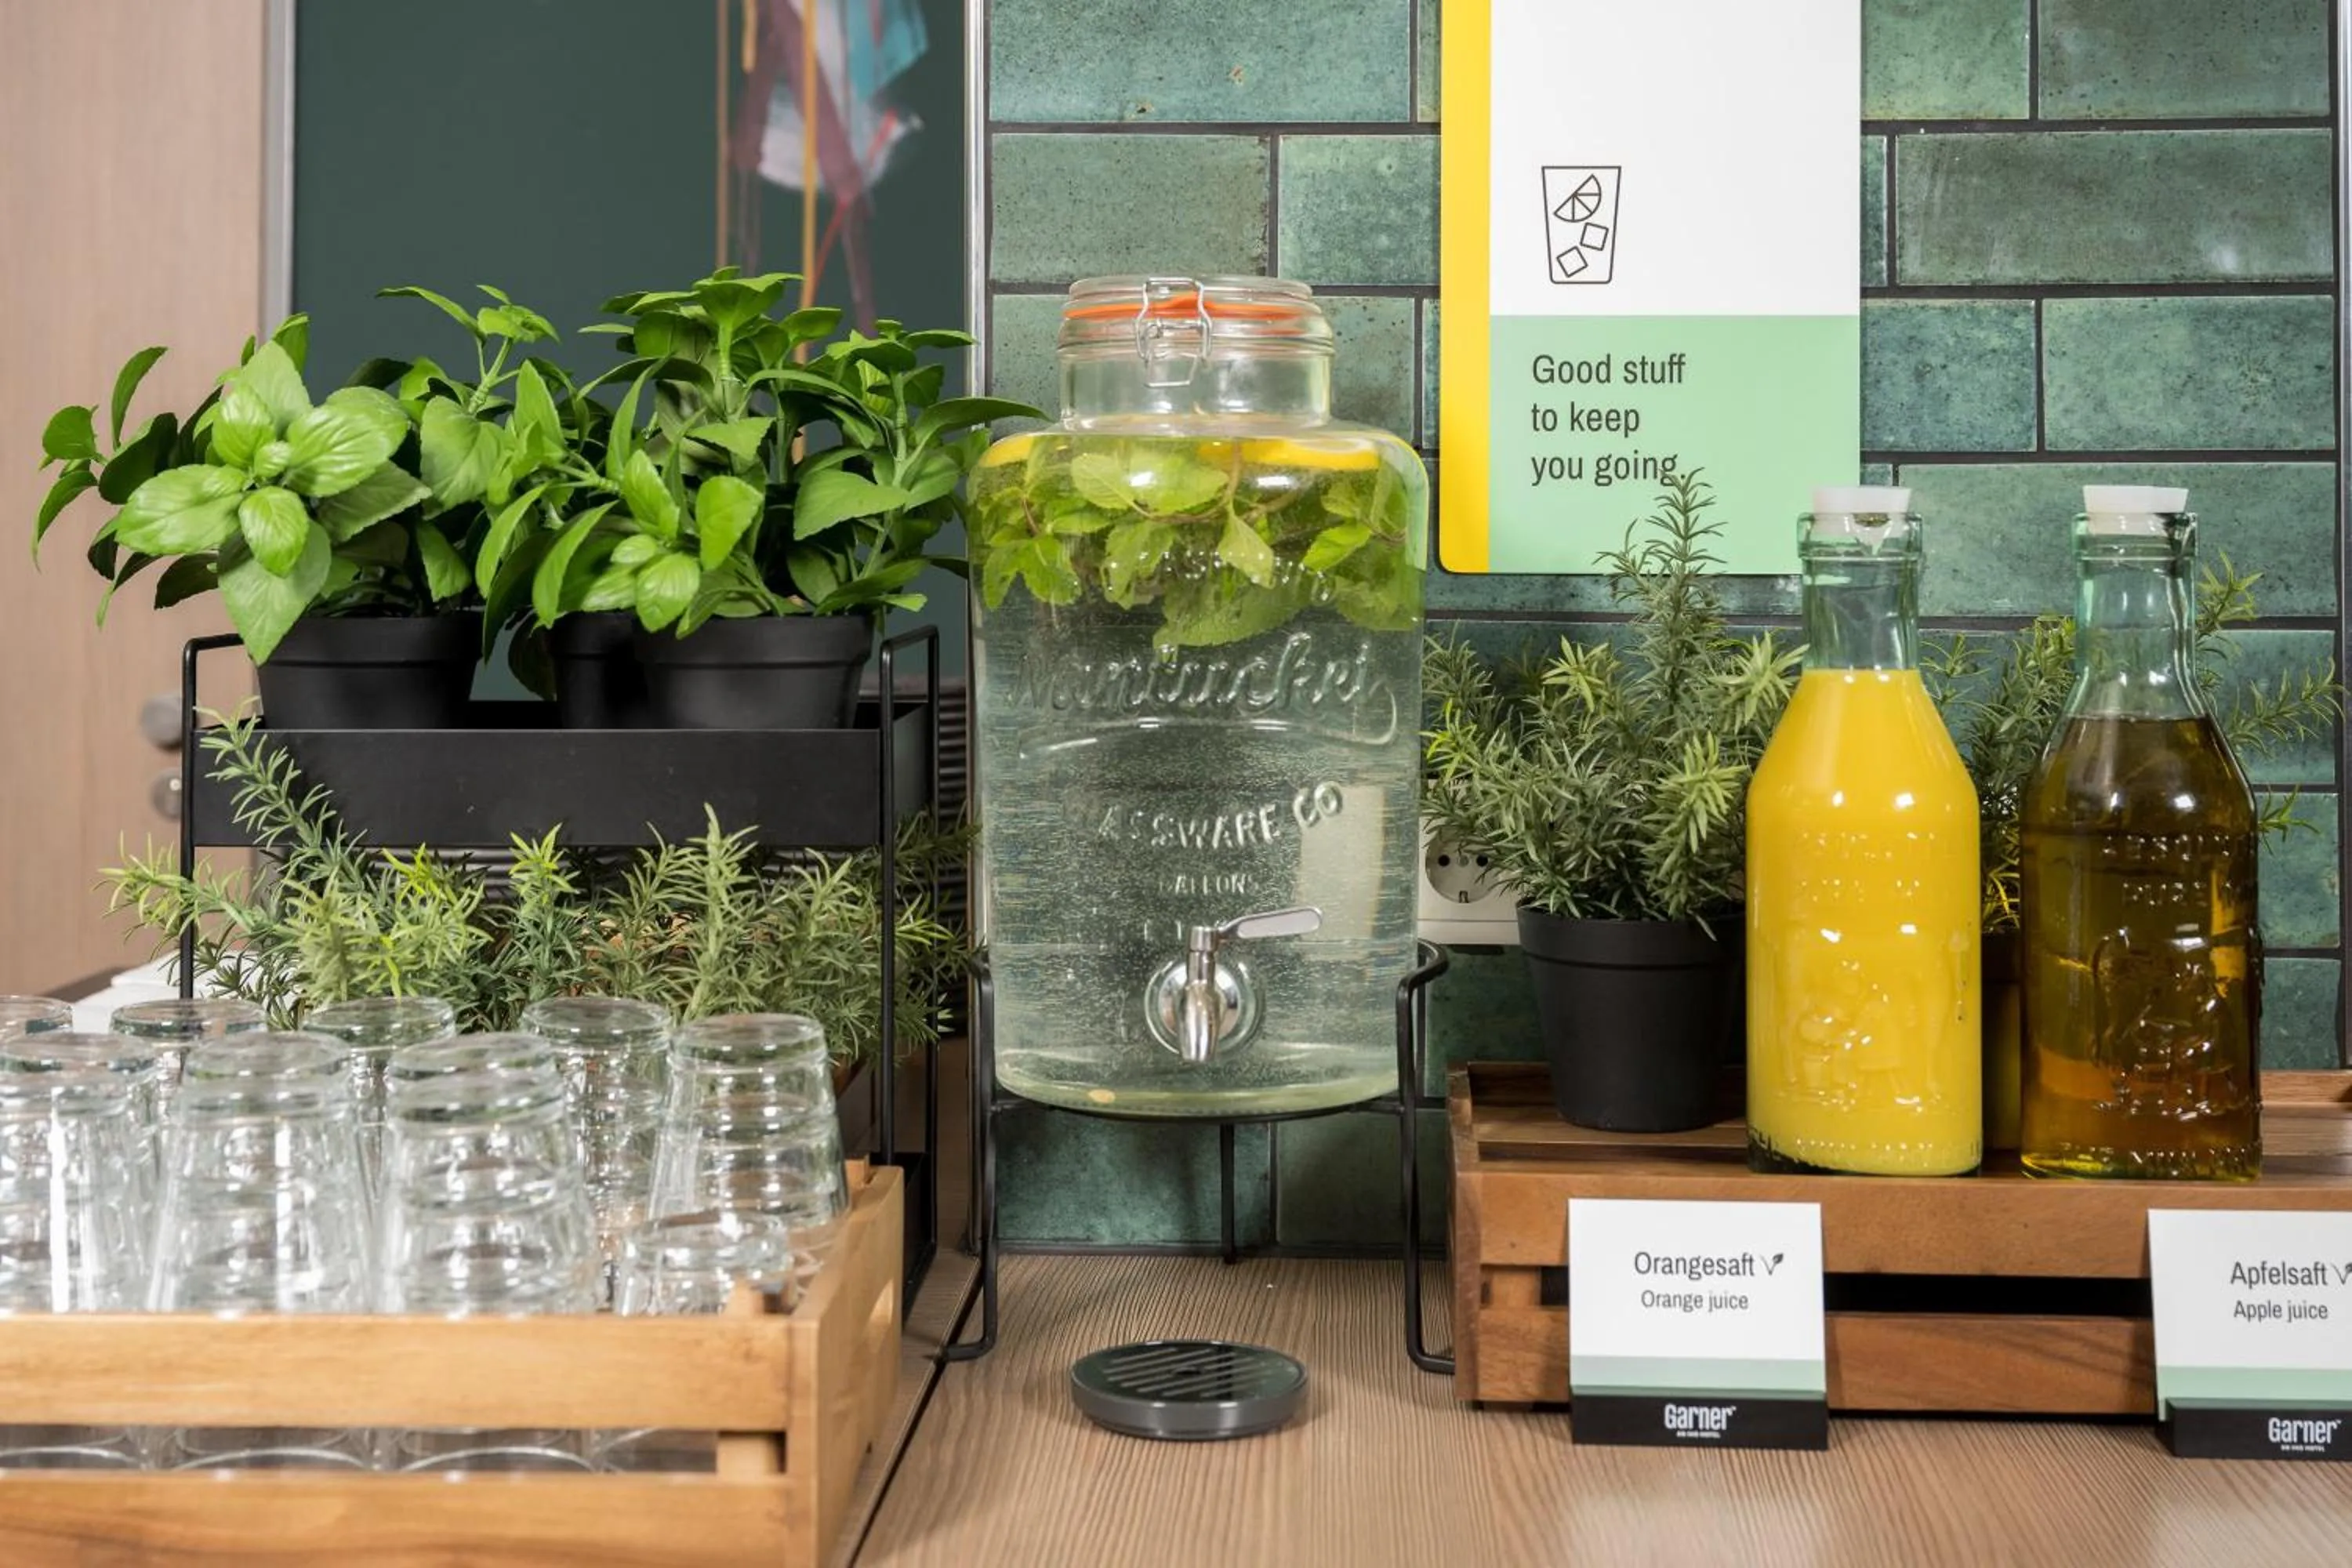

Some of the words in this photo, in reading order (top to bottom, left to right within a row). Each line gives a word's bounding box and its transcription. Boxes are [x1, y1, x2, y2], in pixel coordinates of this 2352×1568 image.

[1532, 353, 1612, 384] Good
[1623, 353, 1687, 384] stuff
[1531, 402, 1559, 432] to
[1570, 401, 1640, 438] keep
[1531, 456, 1584, 487] you
[1634, 1251, 1755, 1281] Orangesaft
[2230, 1260, 2328, 1290] Apfelsaft
[1641, 1290, 1704, 1313] Orange
[1708, 1290, 1749, 1313] juice
[2233, 1299, 2283, 1323] Apple
[2286, 1299, 2329, 1323] juice
[1664, 1403, 1737, 1432] Garner
[2267, 1417, 2342, 1444] Garner
